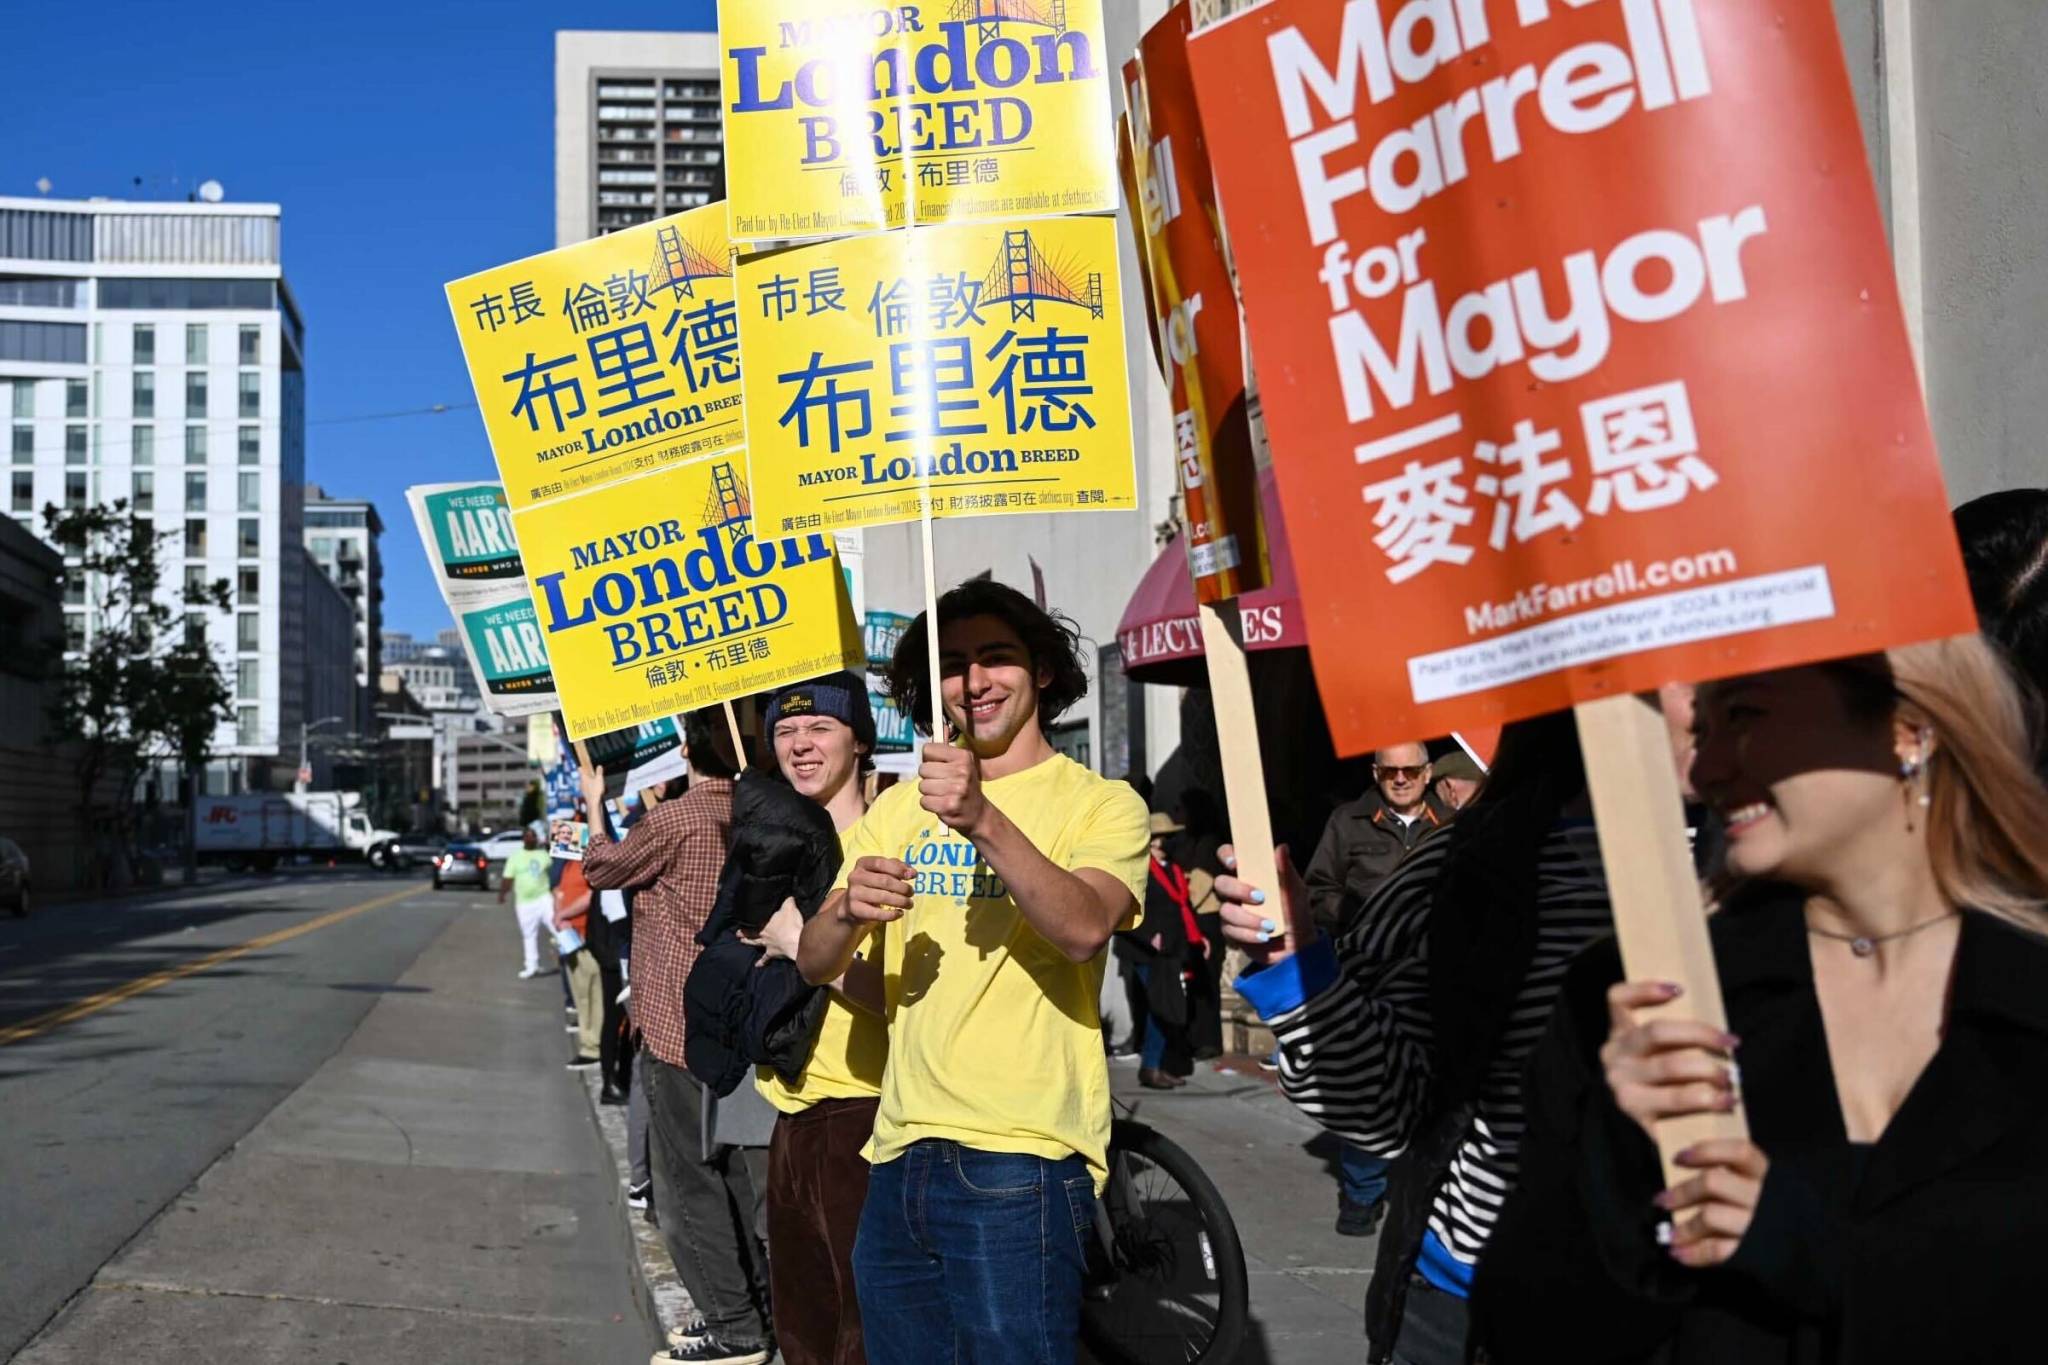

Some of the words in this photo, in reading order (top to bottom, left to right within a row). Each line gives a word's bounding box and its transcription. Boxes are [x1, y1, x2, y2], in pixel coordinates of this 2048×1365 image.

[779, 6, 925, 48] MOR
[729, 22, 1101, 113] London
[1266, 0, 1599, 139] Mar
[799, 97, 1033, 165] BREED
[1291, 0, 1711, 246] Farrell
[736, 214, 753, 233] Paid
[755, 213, 766, 230] for
[768, 213, 778, 235] by
[1015, 190, 1050, 210] available
[1051, 193, 1060, 208] at
[470, 281, 545, 332] 市長
[562, 269, 658, 334] 倫敦
[757, 267, 846, 322] 市長
[868, 271, 986, 338] 倫敦
[1319, 227, 1426, 311] for
[1328, 205, 1767, 424] Mayor
[502, 299, 742, 433] 布里德
[777, 327, 1096, 453] 布里德
[536, 440, 584, 463] MAYOR
[582, 403, 705, 455] London
[705, 392, 742, 413] BREE
[798, 466, 857, 487] MAYOR
[859, 443, 1018, 486] London
[1021, 448, 1080, 464] BREED
[449, 498, 464, 507] WE
[466, 495, 495, 506] NEED
[1362, 380, 1718, 584] 麥法恩
[535, 524, 832, 633] London
[570, 518, 686, 571] MAYOR
[484, 613, 503, 624] WE
[604, 582, 789, 667] BREED
[1418, 657, 1452, 675] Paid
[1454, 651, 1475, 667] for
[1579, 620, 1600, 634] for
[1606, 607, 1663, 627] Mayor
[1728, 576, 1817, 603] Financial
[1464, 548, 1737, 635] MarkFarrell.com
[1457, 658, 1533, 688] disclosures
[1559, 633, 1630, 662] available
[1636, 627, 1654, 643] at
[914, 871, 1008, 898] BREED
